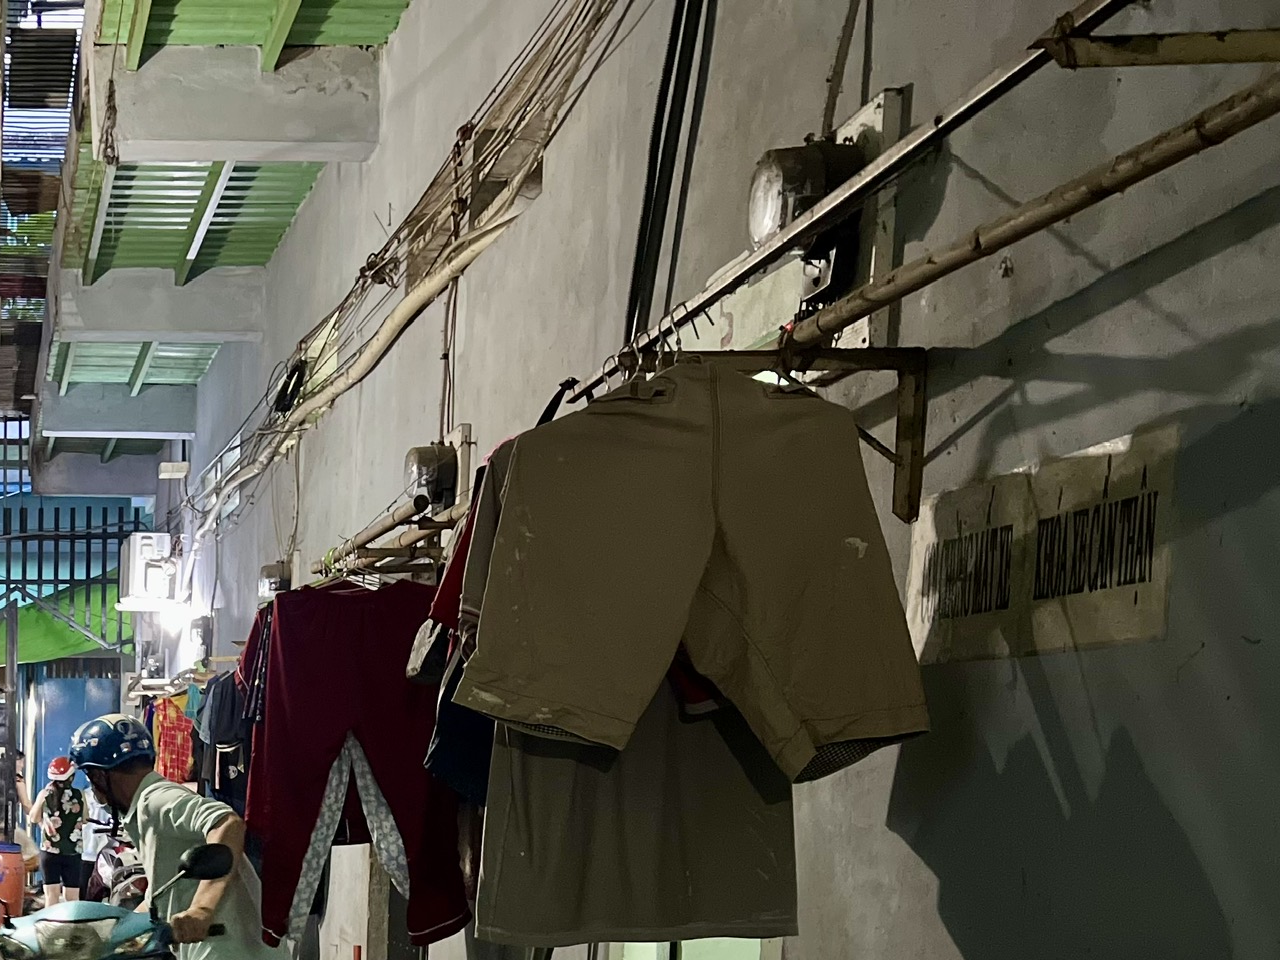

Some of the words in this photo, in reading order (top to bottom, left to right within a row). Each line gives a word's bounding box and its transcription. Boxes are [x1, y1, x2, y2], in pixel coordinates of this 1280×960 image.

[972, 485, 998, 614] MẤT
[996, 524, 1013, 610] XE
[1033, 487, 1068, 600] KHÓA
[1067, 508, 1089, 594] XE
[1117, 465, 1158, 605] THẬN
